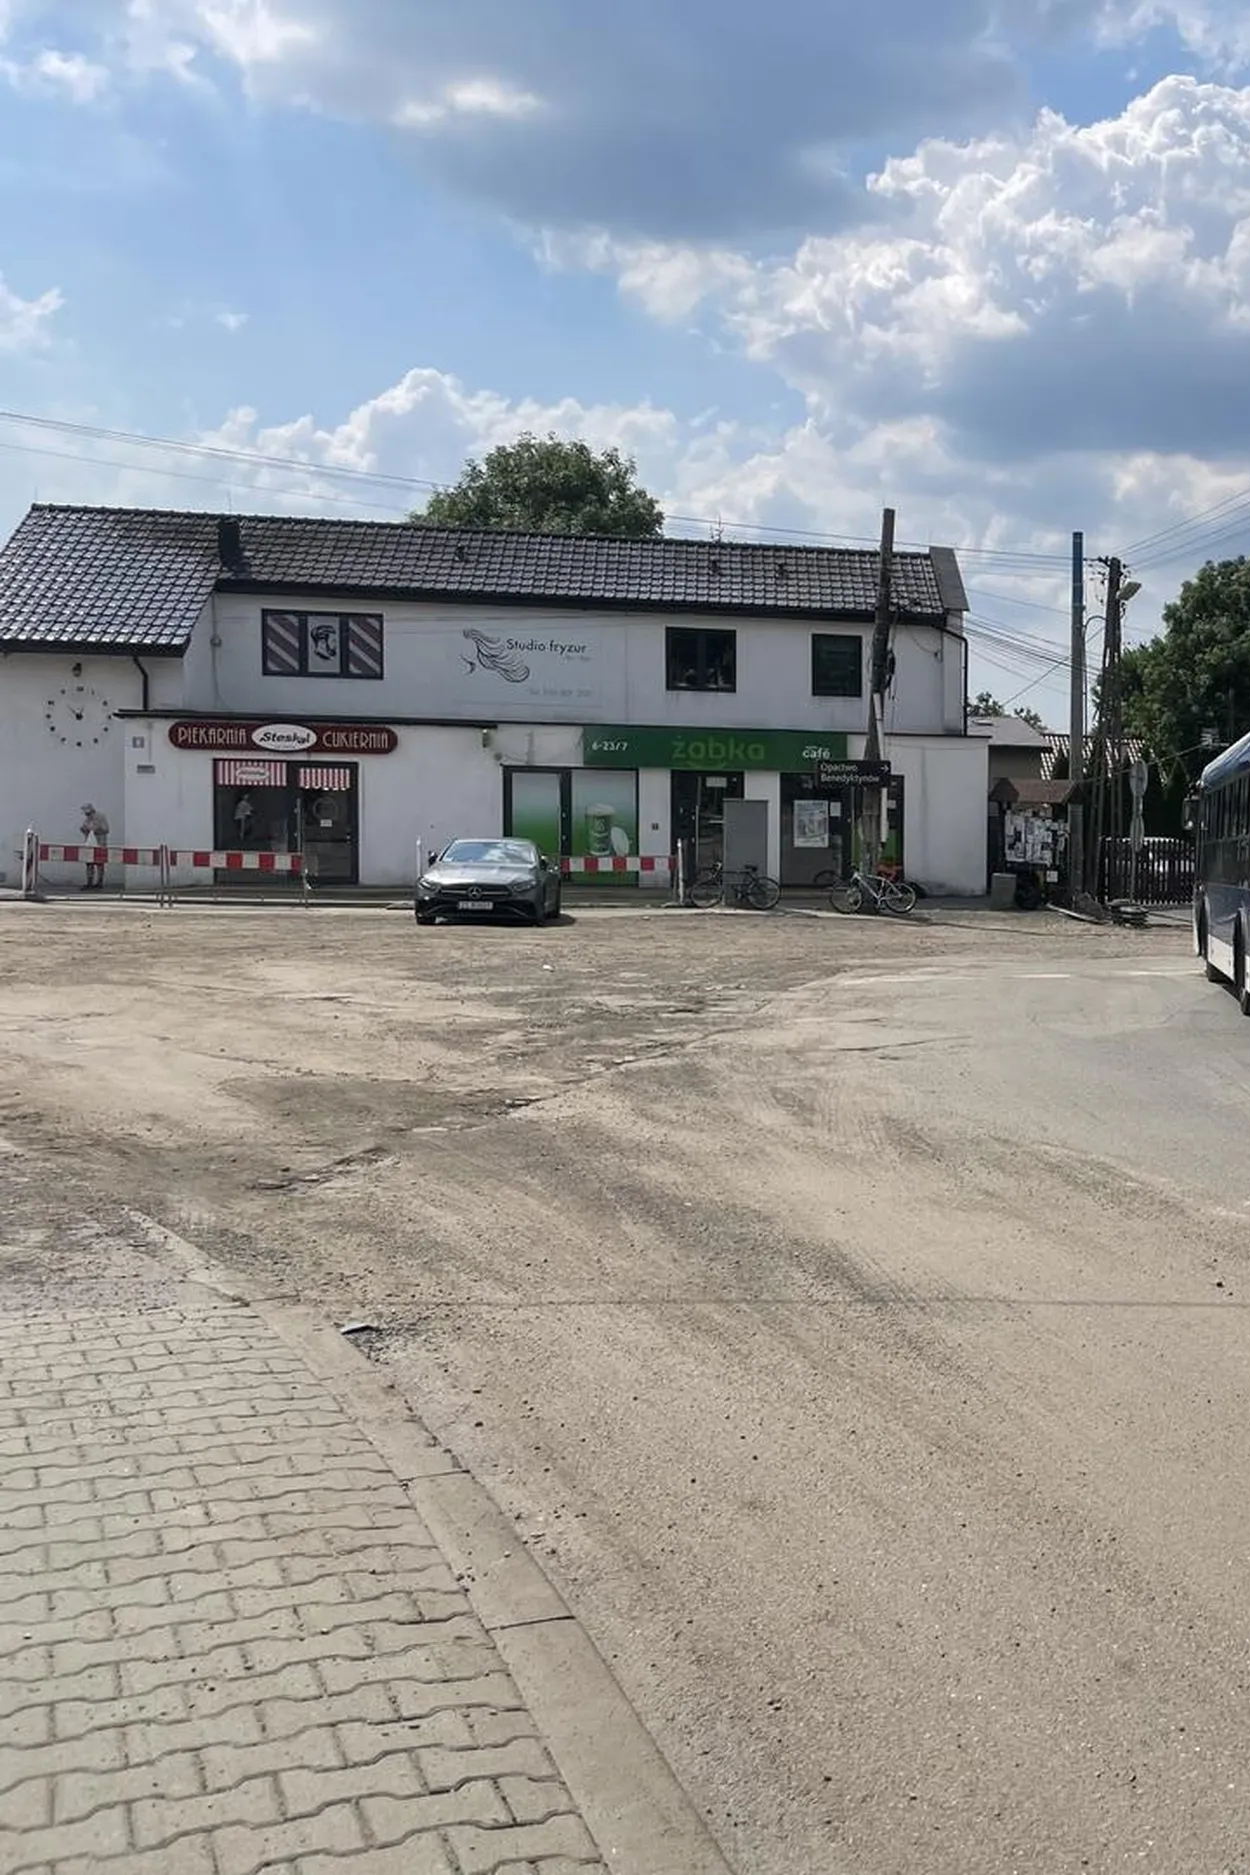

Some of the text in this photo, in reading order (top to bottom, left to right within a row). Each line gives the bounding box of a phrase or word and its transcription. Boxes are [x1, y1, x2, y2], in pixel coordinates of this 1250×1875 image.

[506, 638, 587, 656] Studio fryzur
[178, 727, 247, 745] PIEKARNIA
[323, 732, 388, 748] CUKIERNIA
[672, 735, 765, 760] żabka
[803, 747, 831, 758] café
